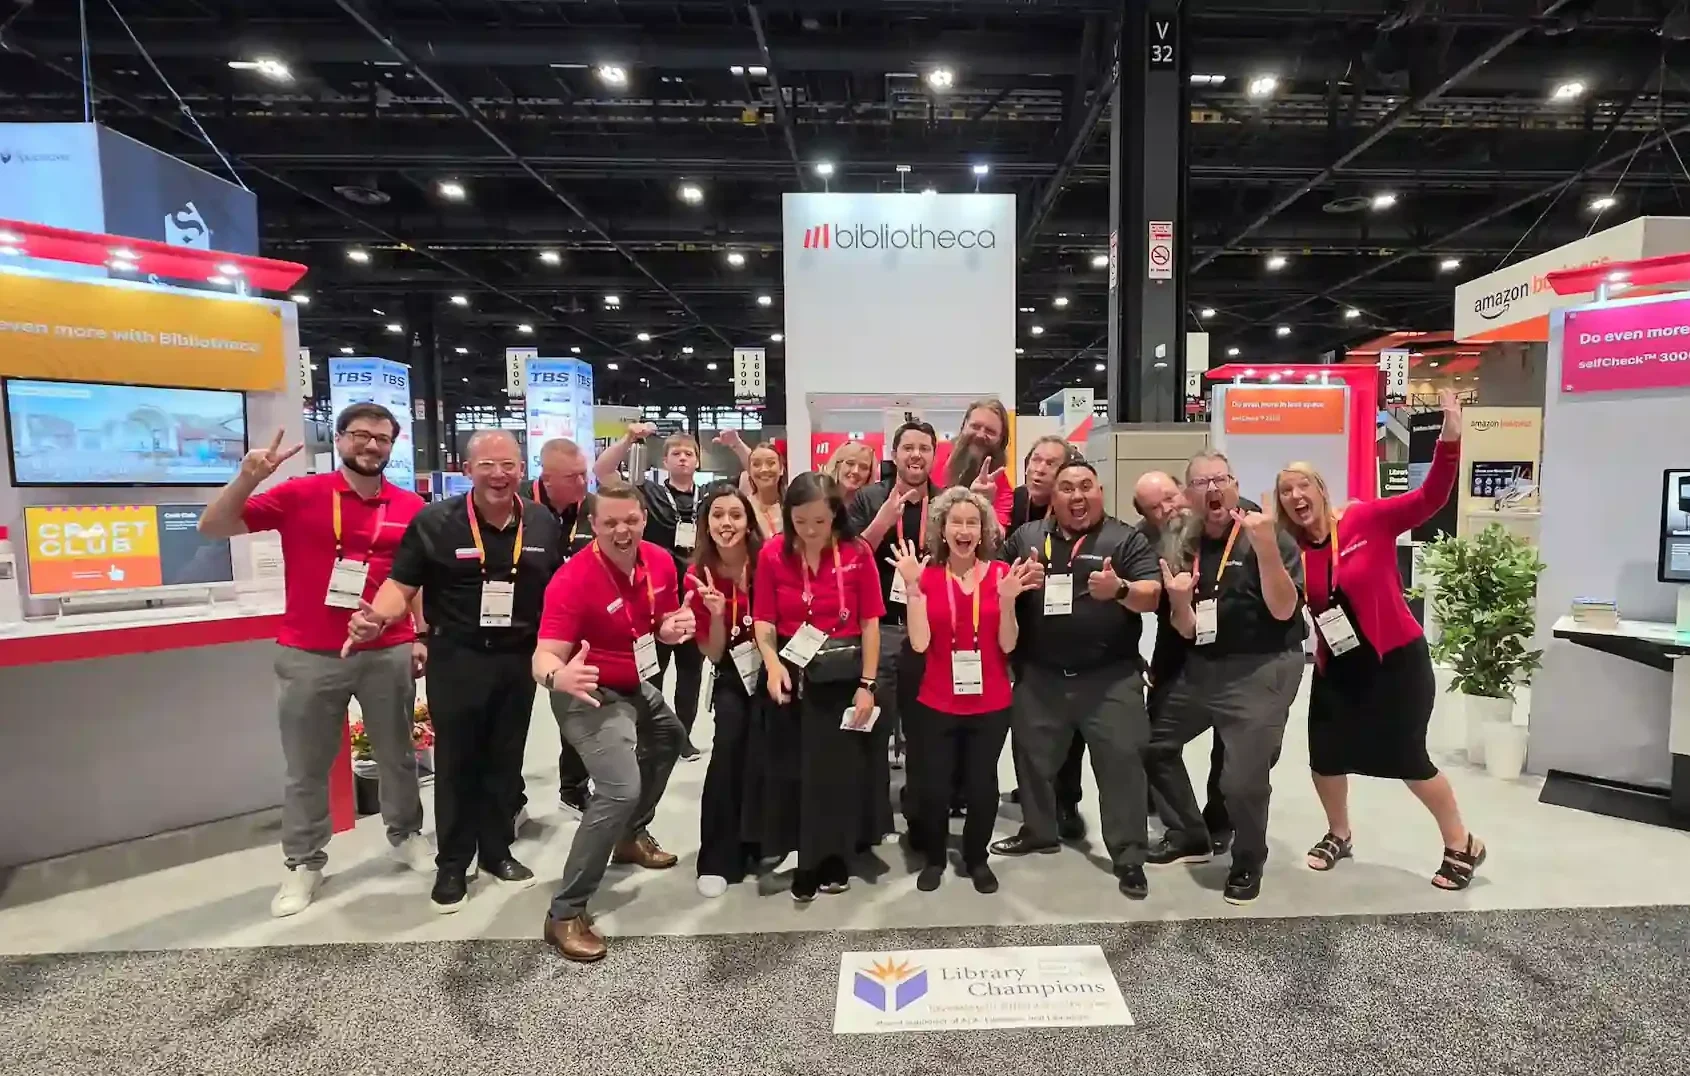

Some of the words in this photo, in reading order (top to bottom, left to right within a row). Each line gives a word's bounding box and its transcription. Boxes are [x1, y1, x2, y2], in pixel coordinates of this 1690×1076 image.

[1156, 21, 1169, 40] V
[1152, 45, 1173, 62] 32
[835, 223, 996, 250] bibliotheca
[1474, 281, 1529, 313] amazon
[55, 324, 107, 340] more
[113, 328, 154, 344] with
[1579, 332, 1601, 346] Do
[1604, 329, 1643, 343] even
[1646, 323, 1690, 340] more
[334, 371, 373, 384] TBS
[382, 372, 406, 388] TBS
[530, 371, 570, 383] TBS
[576, 373, 592, 388] TBS
[38, 521, 150, 540] CRAFT
[39, 537, 134, 557] CLUB
[940, 967, 1027, 982] Library
[968, 980, 1106, 999] Champions
